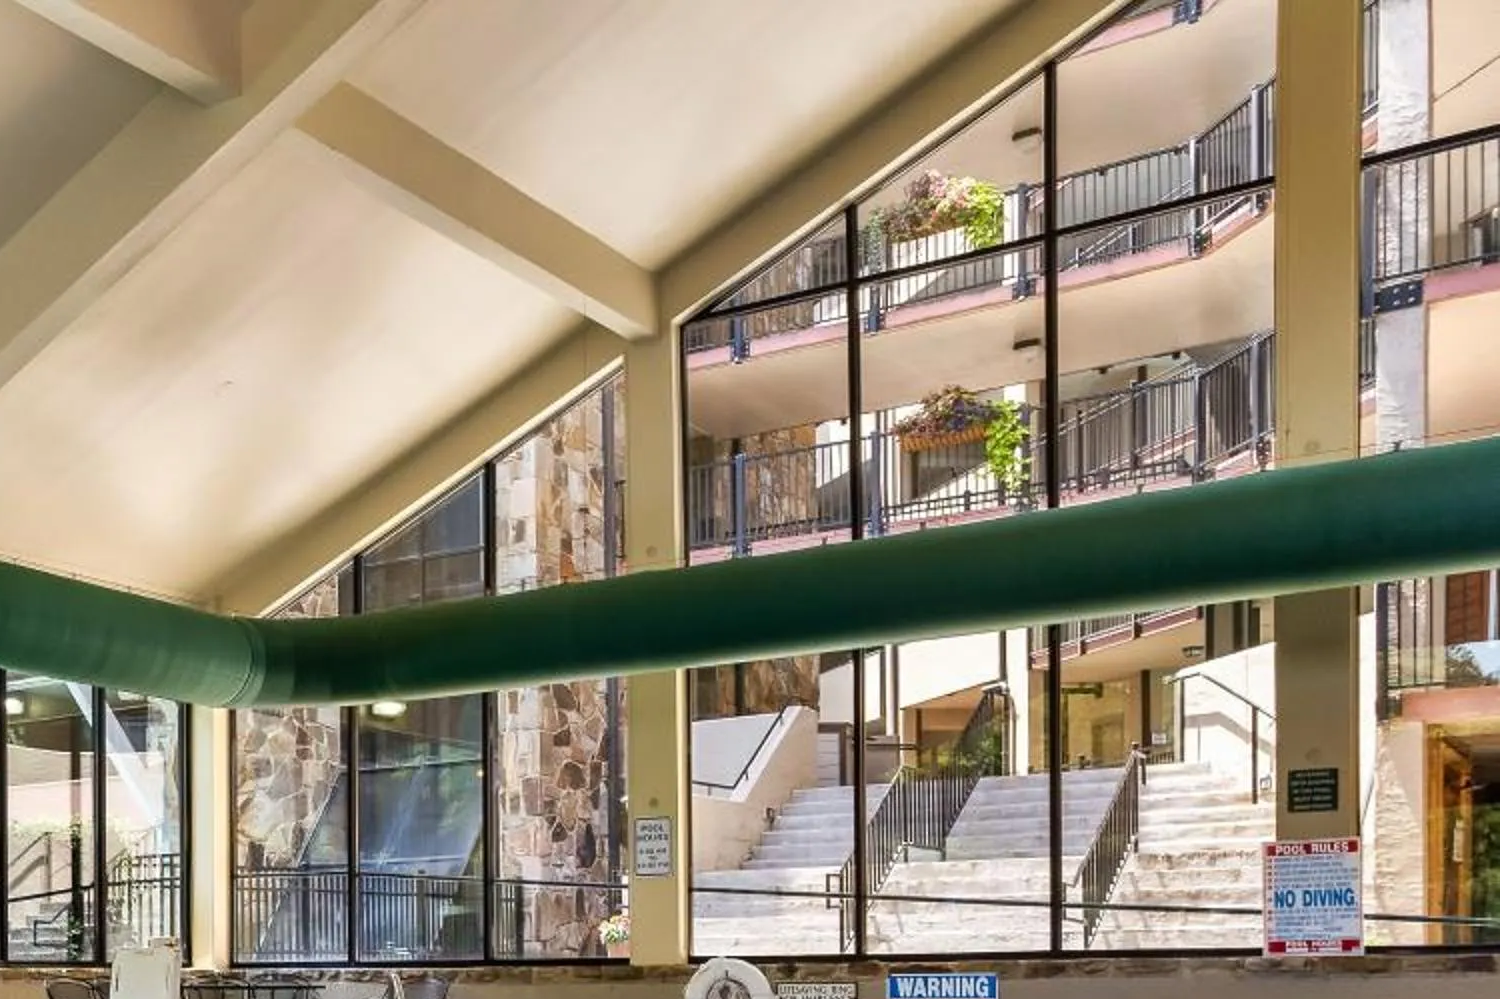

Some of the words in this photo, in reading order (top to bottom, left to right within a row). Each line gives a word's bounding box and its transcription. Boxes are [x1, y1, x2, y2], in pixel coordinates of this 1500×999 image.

[1276, 845, 1304, 855] POOL
[1311, 842, 1348, 853] RULES
[1275, 890, 1296, 908] NO
[898, 977, 989, 997] WARNING
